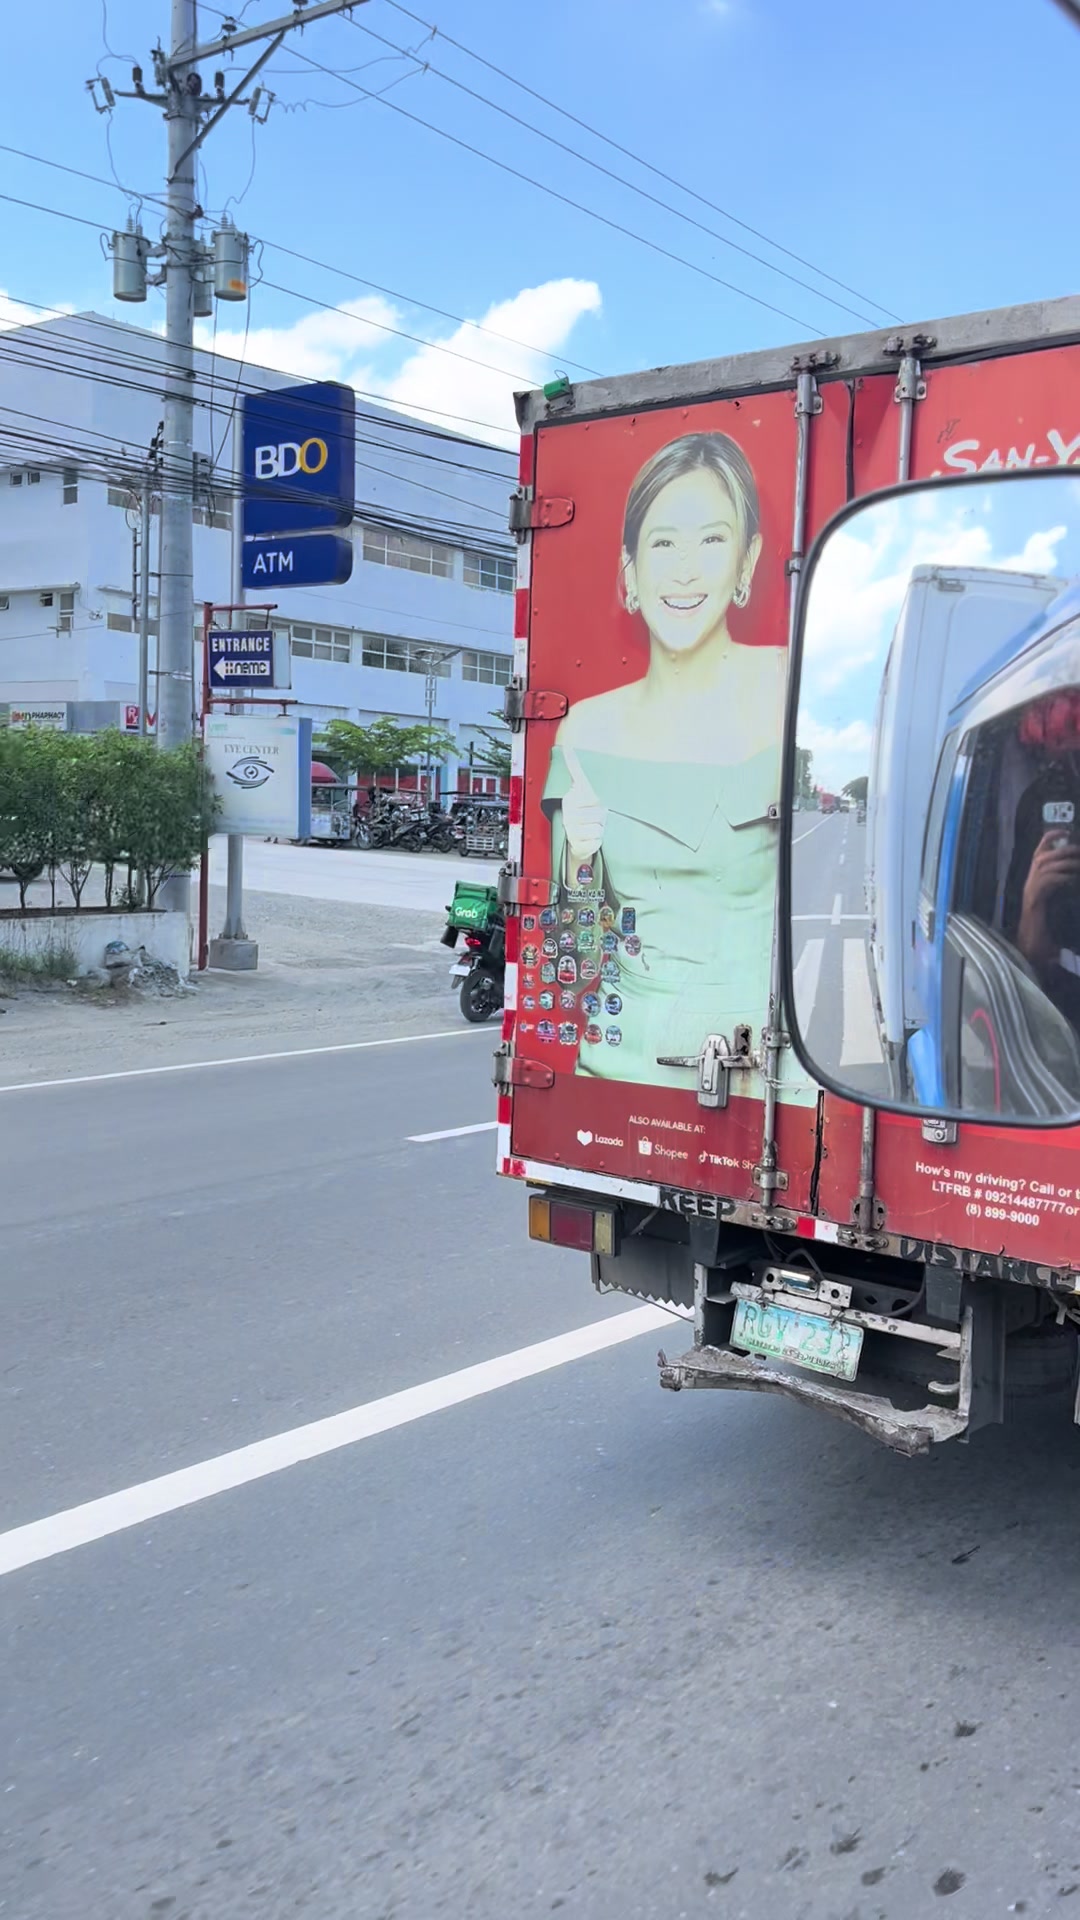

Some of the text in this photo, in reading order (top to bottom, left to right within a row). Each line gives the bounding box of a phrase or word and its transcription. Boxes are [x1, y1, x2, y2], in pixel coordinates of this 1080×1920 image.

[255, 437, 328, 480] BDO
[253, 551, 293, 574] ATM
[212, 637, 270, 652] ENTRANCE
[224, 744, 279, 755] EYE CENTER
[455, 907, 478, 919] Grab
[628, 1115, 706, 1134] ALSO AVAILABLE AT:
[595, 1133, 624, 1147] Lazada
[654, 1143, 689, 1160] Shopee
[709, 1154, 740, 1168] TikTok
[915, 1161, 951, 1178] How's
[953, 1169, 972, 1184] my
[975, 1172, 1026, 1192] driving?
[1029, 1180, 1054, 1196] Call
[1058, 1187, 1072, 1198] or
[931, 1180, 971, 1197] LTFRB
[974, 1188, 982, 1199] #
[660, 1186, 736, 1219] KEEP
[965, 1202, 1040, 1227] (8) 899-9000
